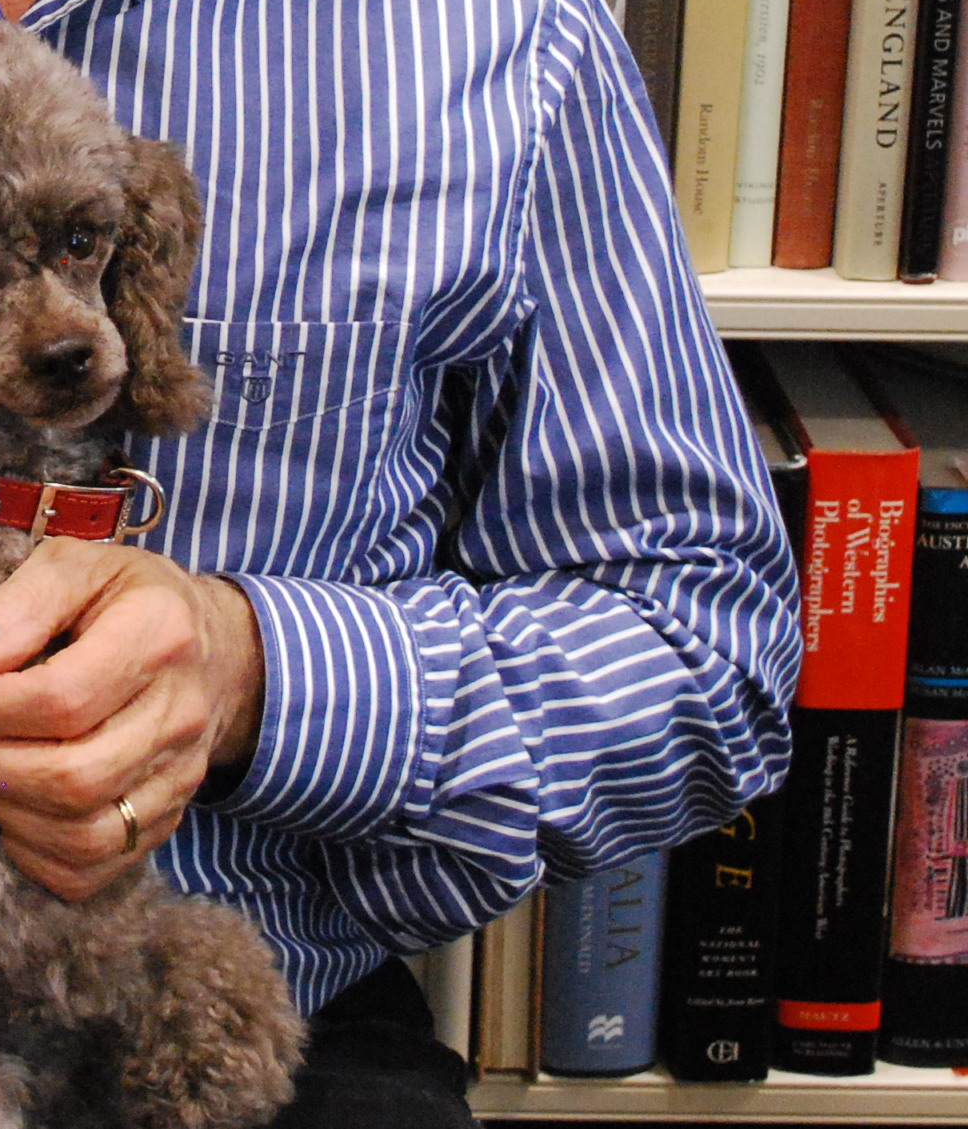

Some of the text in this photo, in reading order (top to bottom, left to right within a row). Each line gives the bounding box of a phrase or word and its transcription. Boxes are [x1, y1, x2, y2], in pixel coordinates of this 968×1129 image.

[932, 9, 955, 52] AND
[692, 103, 713, 217] Random House
[926, 57, 950, 151] MARVELS
[873, 182, 887, 247] APERTURE
[805, 500, 841, 653] Photographers
[841, 498, 874, 614] of Western
[870, 499, 905, 623] Biographies
